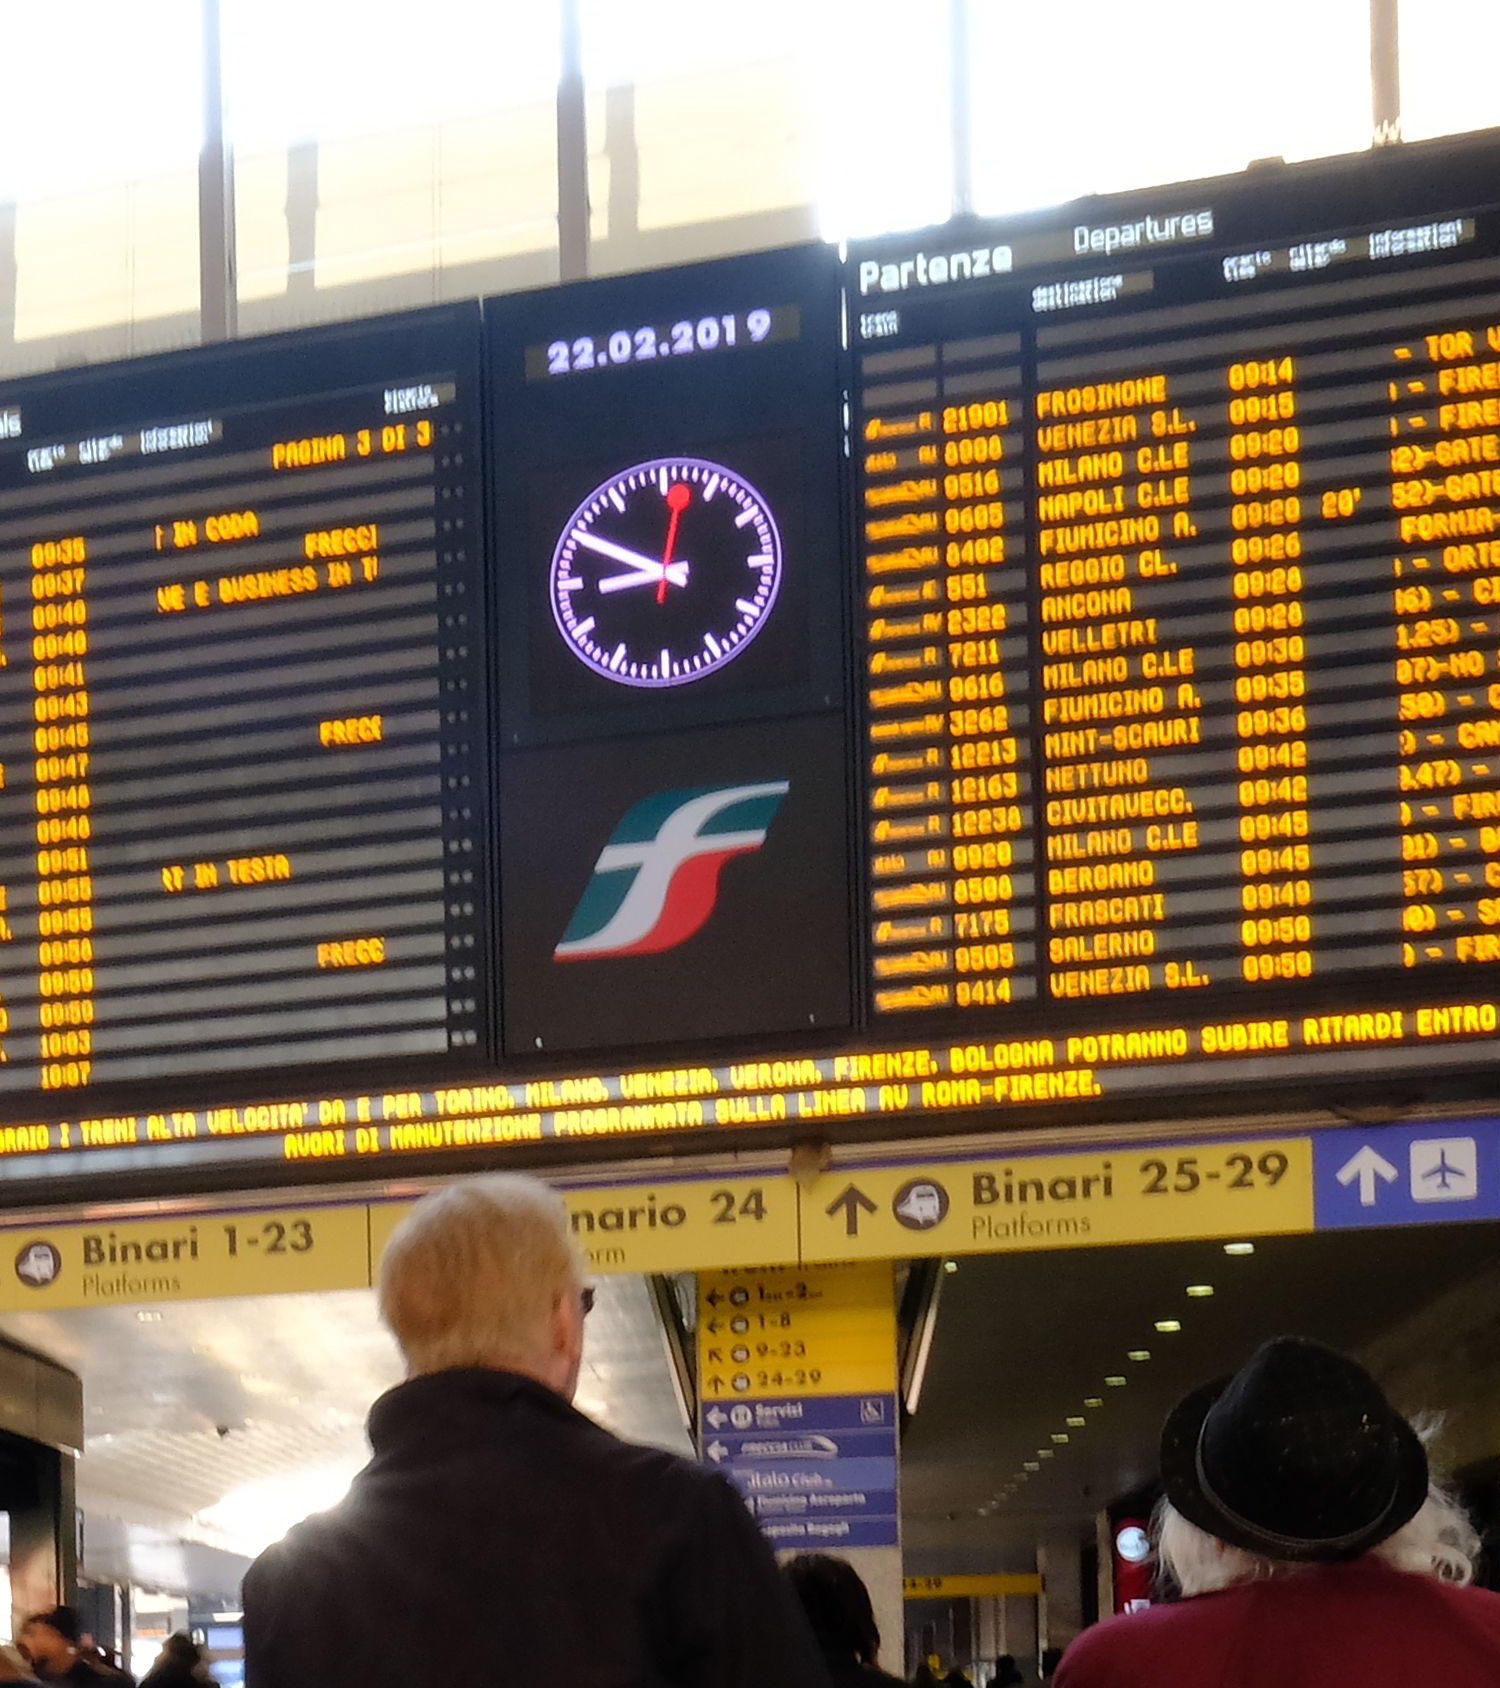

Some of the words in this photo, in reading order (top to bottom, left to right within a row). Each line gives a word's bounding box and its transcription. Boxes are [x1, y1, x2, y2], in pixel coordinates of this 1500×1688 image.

[1073, 210, 1213, 255] Departures
[859, 245, 1013, 296] Partenze
[547, 308, 771, 374] 22.02.2019
[273, 435, 345, 467] PAGINA
[382, 425, 406, 452] DI
[971, 1162, 1114, 1207] Binari
[1138, 1151, 1289, 1197] 25-29
[571, 1194, 687, 1233] nario
[709, 1189, 768, 1225] 24
[971, 1212, 1091, 1241] Platforms
[82, 1226, 200, 1266] Binari
[221, 1220, 315, 1259] 1-23
[82, 1271, 182, 1298] Platforms
